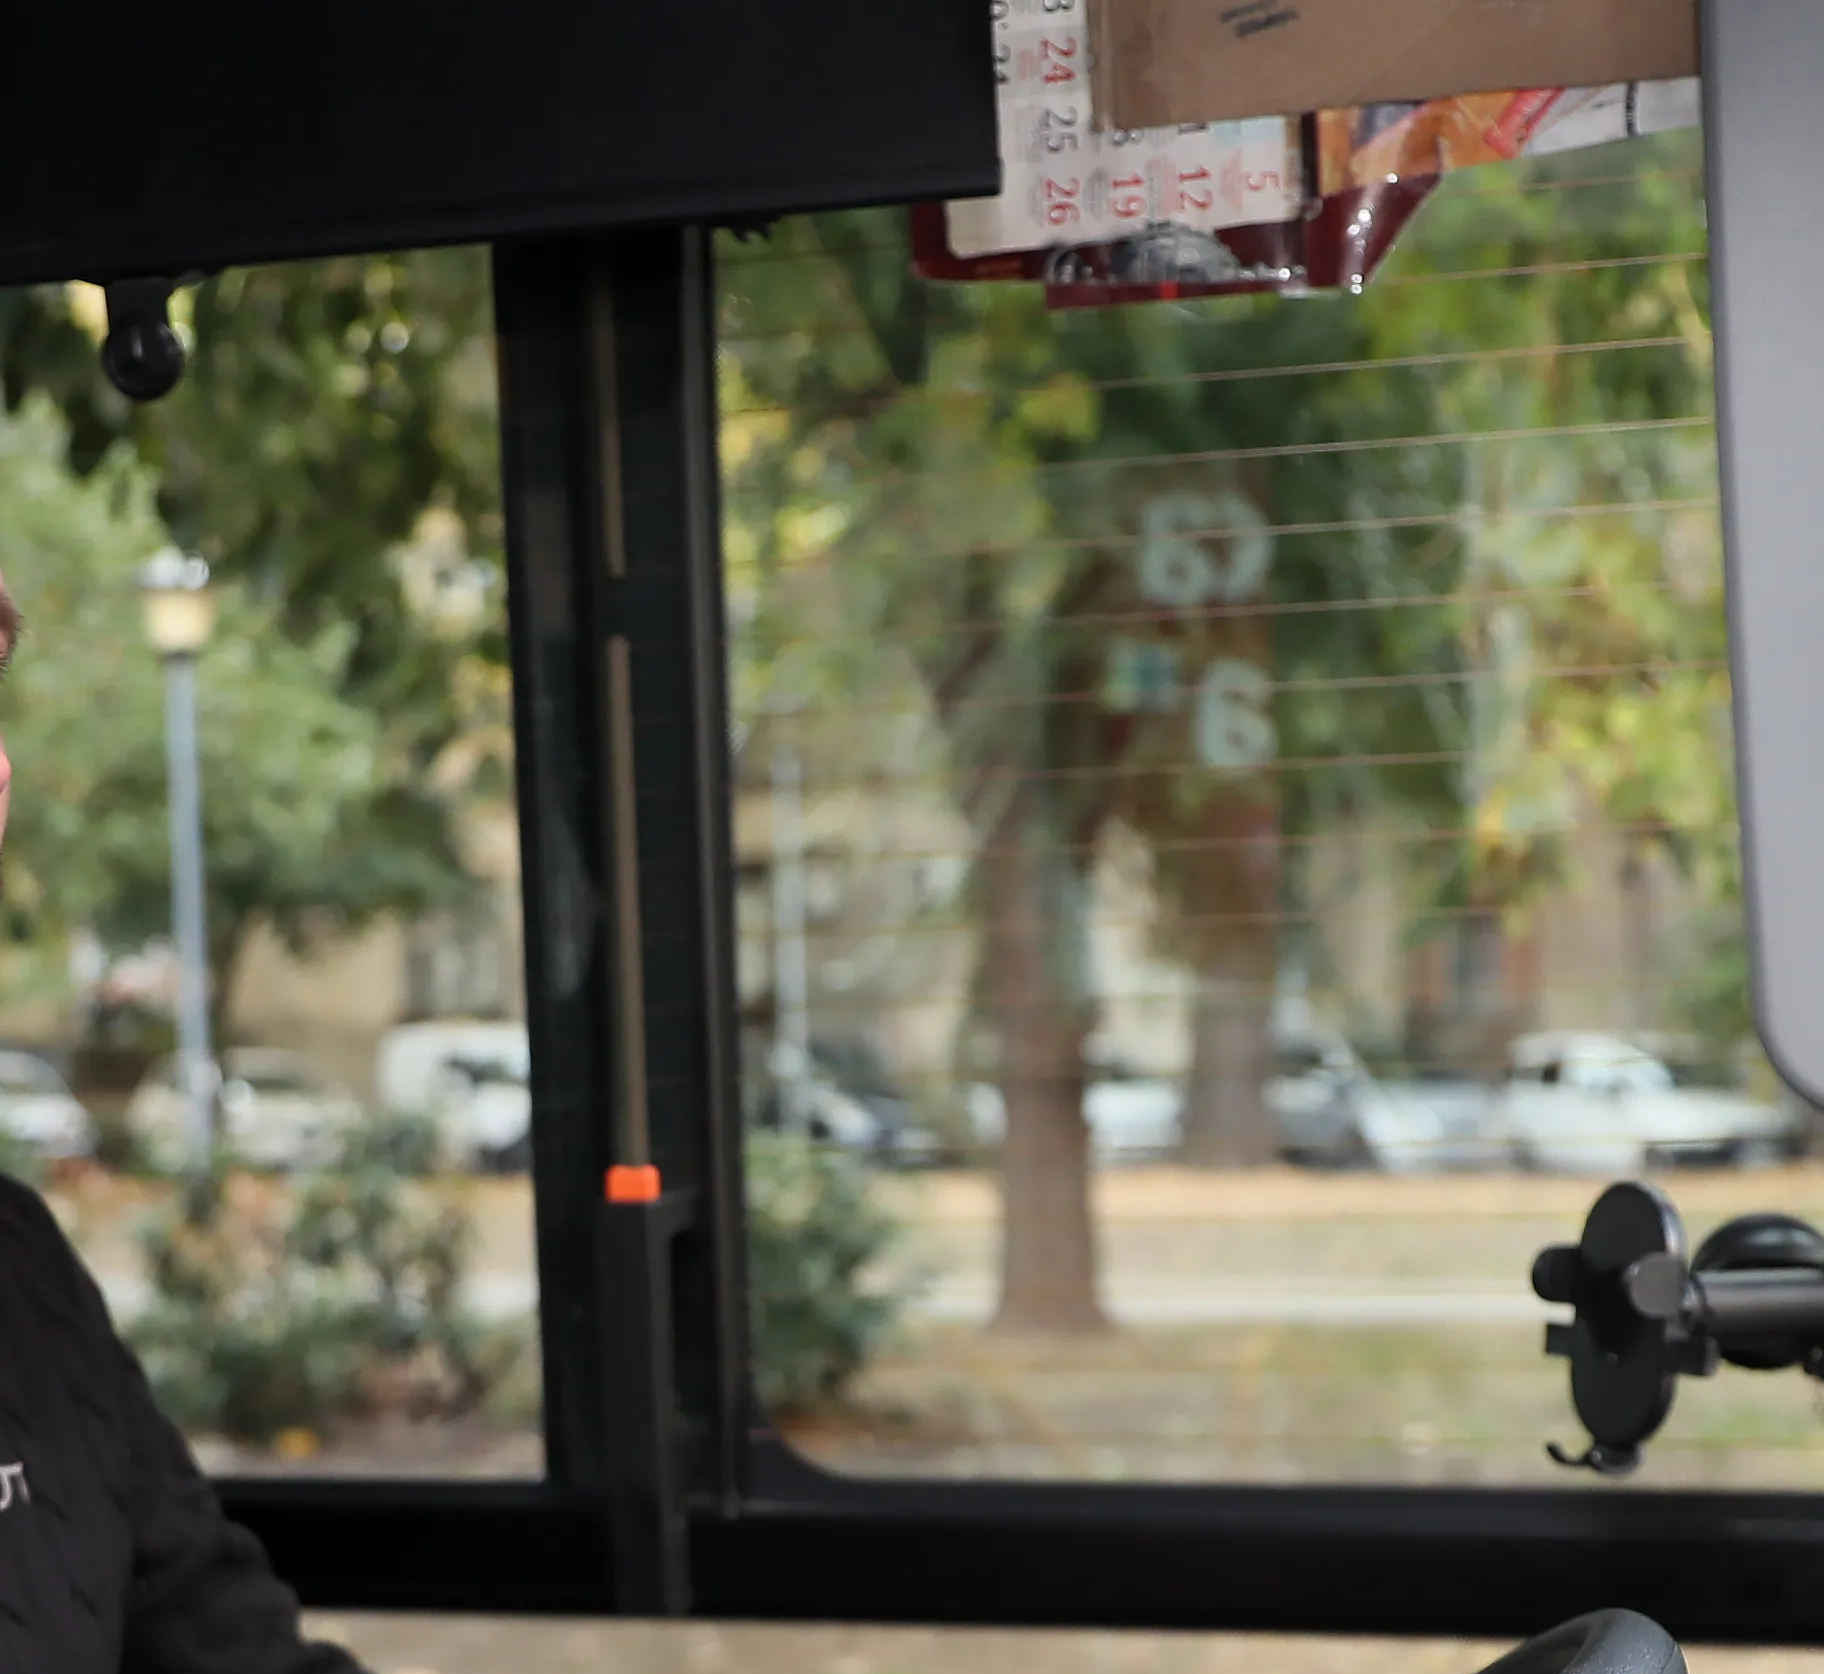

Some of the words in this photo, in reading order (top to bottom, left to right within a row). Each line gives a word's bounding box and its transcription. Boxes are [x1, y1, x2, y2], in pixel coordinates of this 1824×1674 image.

[1039, 36, 1077, 86] 24
[1042, 106, 1078, 154] 25
[1044, 176, 1080, 228] 26
[1110, 172, 1146, 219] 19
[1178, 164, 1214, 211] 12
[1245, 170, 1281, 192] 5
